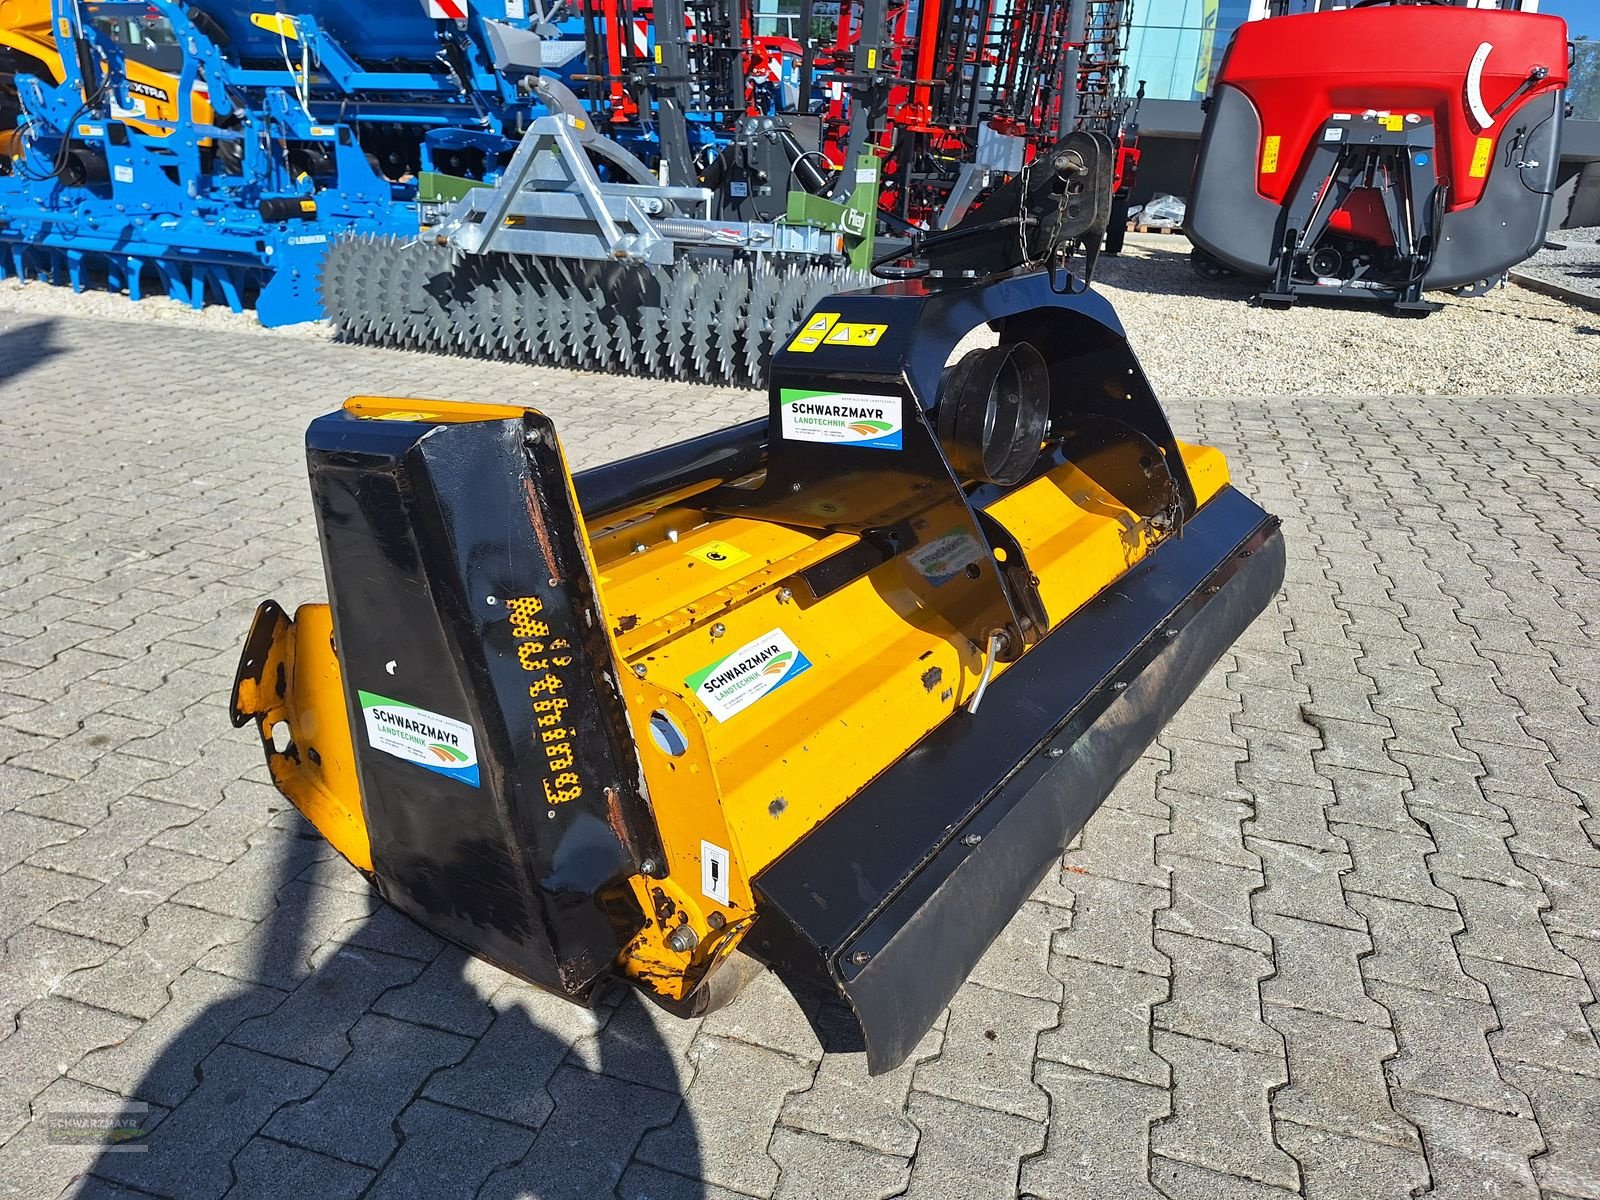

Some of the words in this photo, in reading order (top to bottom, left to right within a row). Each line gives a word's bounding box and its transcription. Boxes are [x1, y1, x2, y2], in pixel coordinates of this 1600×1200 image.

[792, 402, 883, 419] SCHWARZMAYR
[794, 417, 846, 428] LANDTECHNIK
[703, 644, 781, 693] SCHWARZMAYR
[715, 671, 761, 701] LANDTECHNIK
[372, 708, 459, 747] SCHWARZMAYR
[377, 724, 426, 747] LANDTECHNIK
